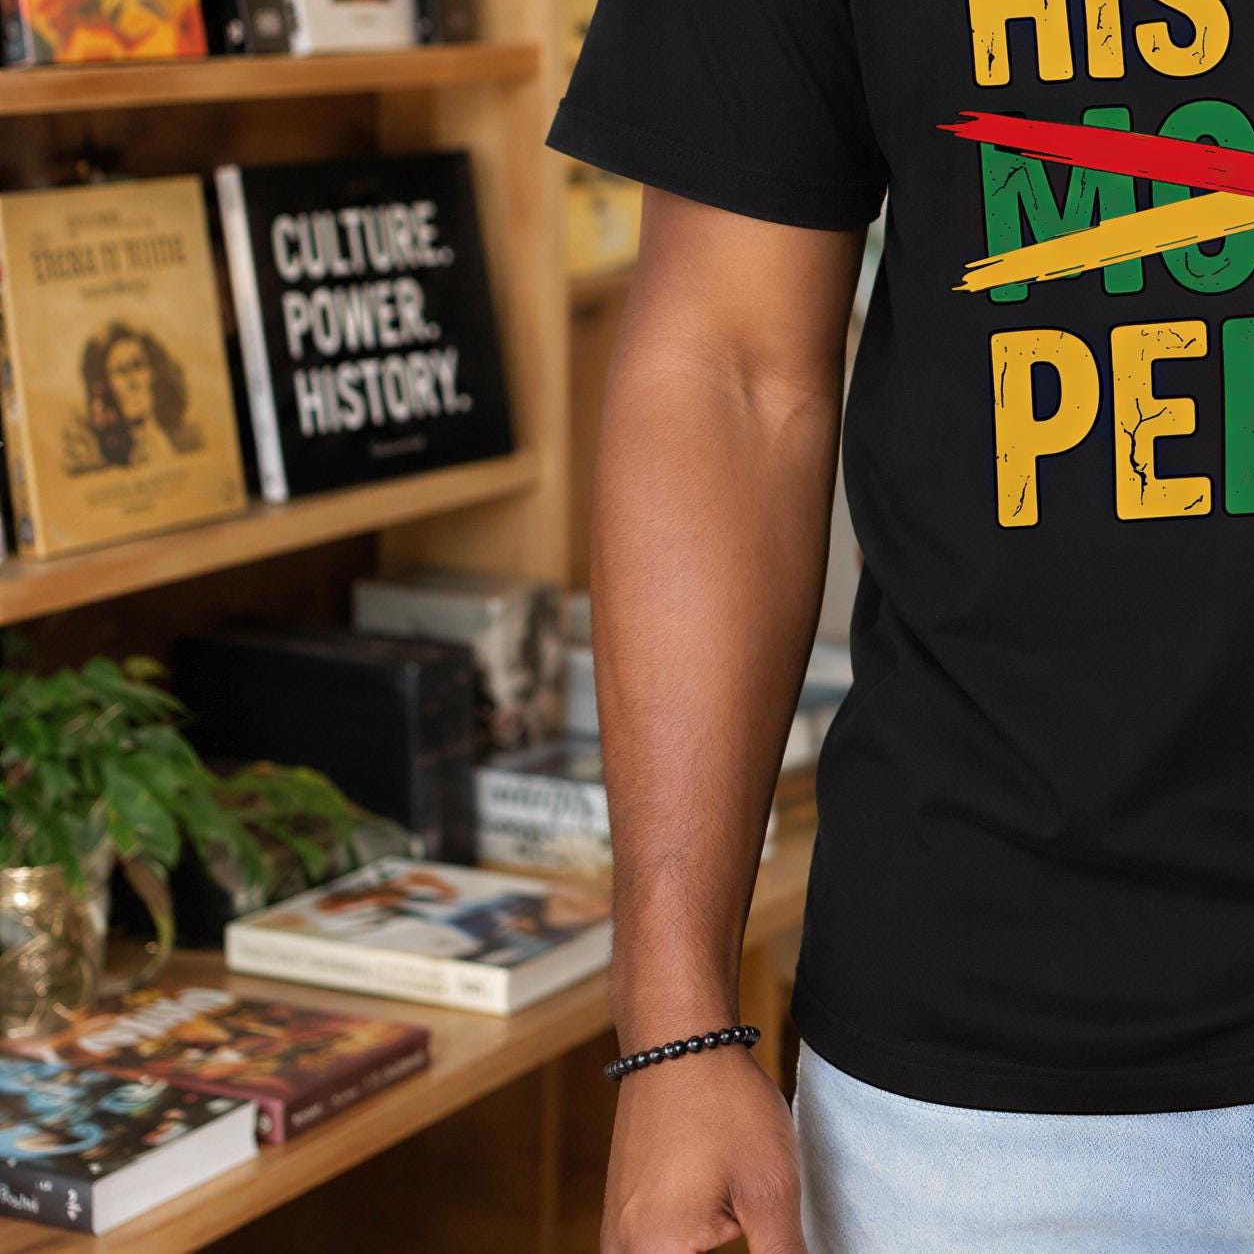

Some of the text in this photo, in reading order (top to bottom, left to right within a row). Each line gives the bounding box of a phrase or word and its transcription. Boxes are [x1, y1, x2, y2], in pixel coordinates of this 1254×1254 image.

[271, 200, 455, 282] CULTURE.
[282, 276, 441, 361] POWER.
[294, 345, 473, 436] HISTORY.
